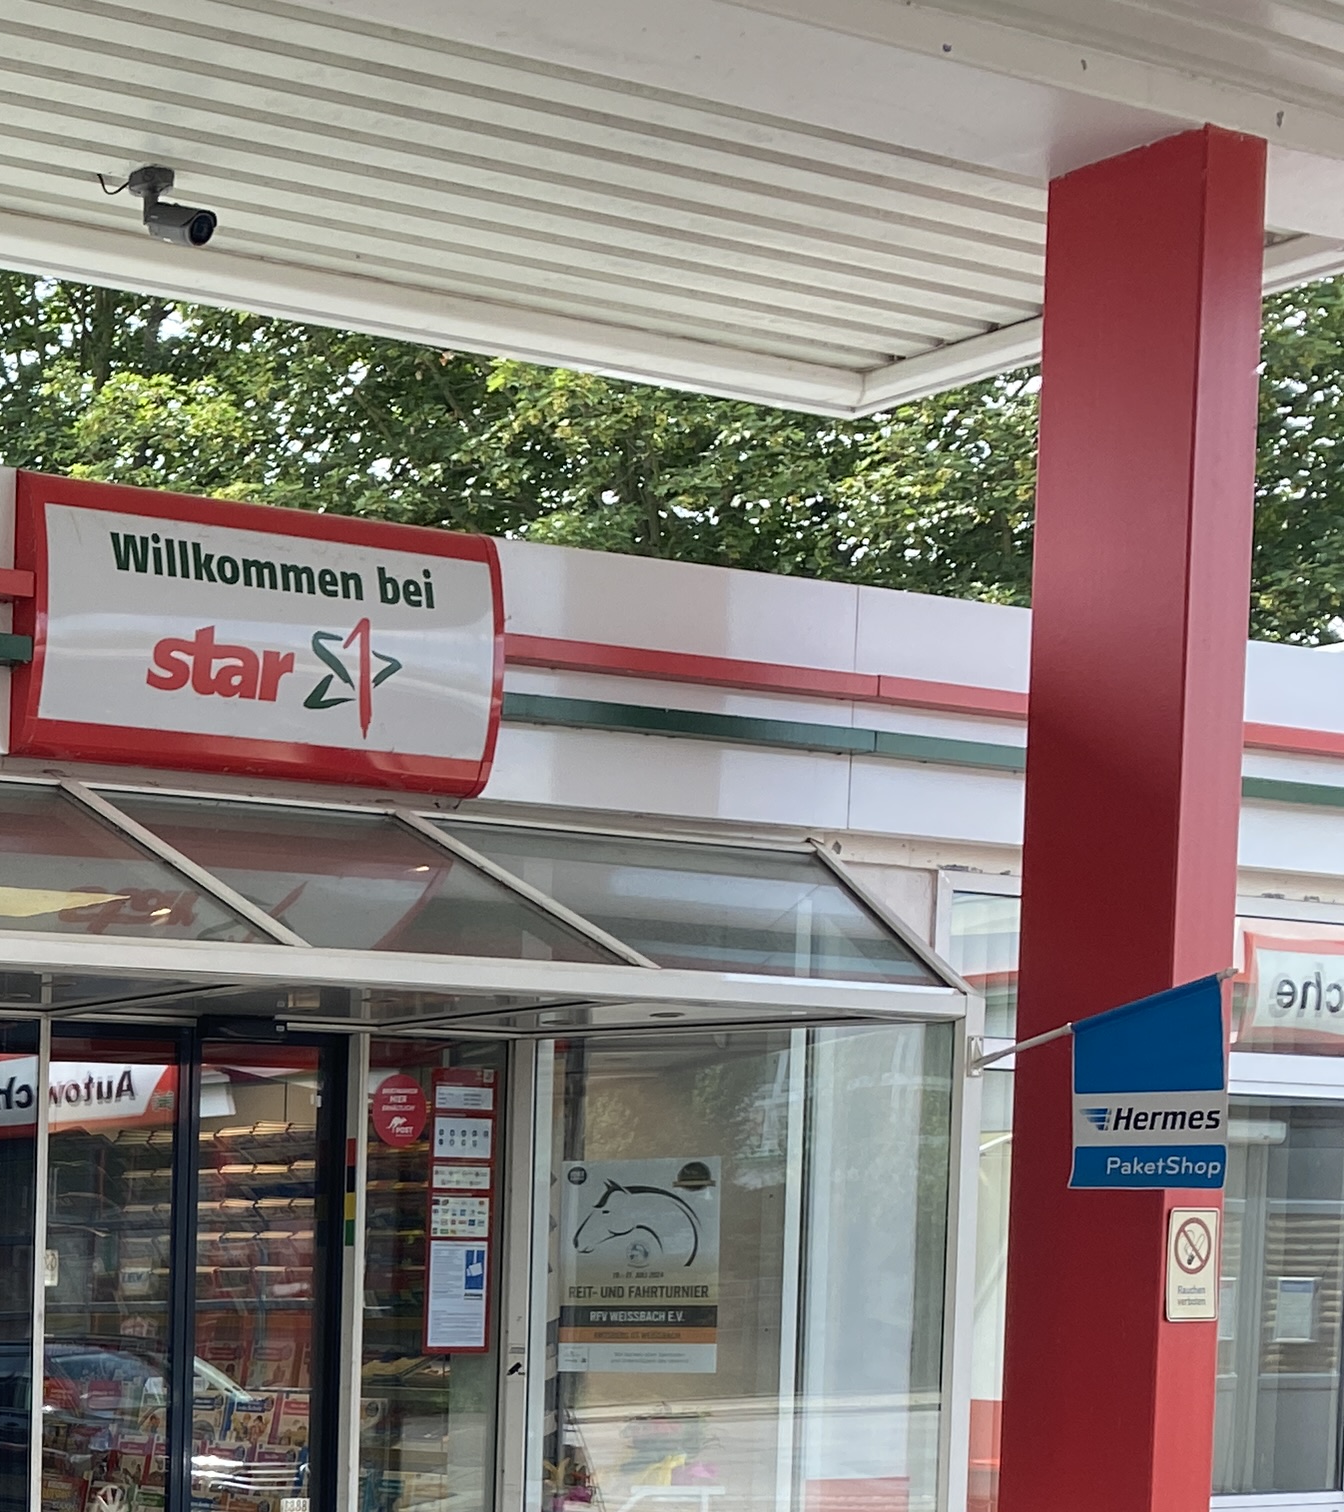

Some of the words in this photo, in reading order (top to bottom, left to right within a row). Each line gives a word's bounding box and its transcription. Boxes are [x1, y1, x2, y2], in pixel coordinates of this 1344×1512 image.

[110, 532, 364, 601] Willkommen
[377, 566, 435, 609] bei
[146, 625, 295, 702] star
[1113, 1107, 1221, 1132] Hermes
[1106, 1155, 1221, 1179] PaketShop
[568, 1286, 598, 1298] REIT-
[600, 1286, 624, 1298] UND
[628, 1285, 709, 1298] FAHRTURNIER
[1177, 1284, 1206, 1294] Rauchen
[1177, 1296, 1206, 1306] verboten
[589, 1311, 607, 1321] RFV
[609, 1311, 665, 1321] WEISSBACH
[667, 1311, 685, 1321] E.V.
